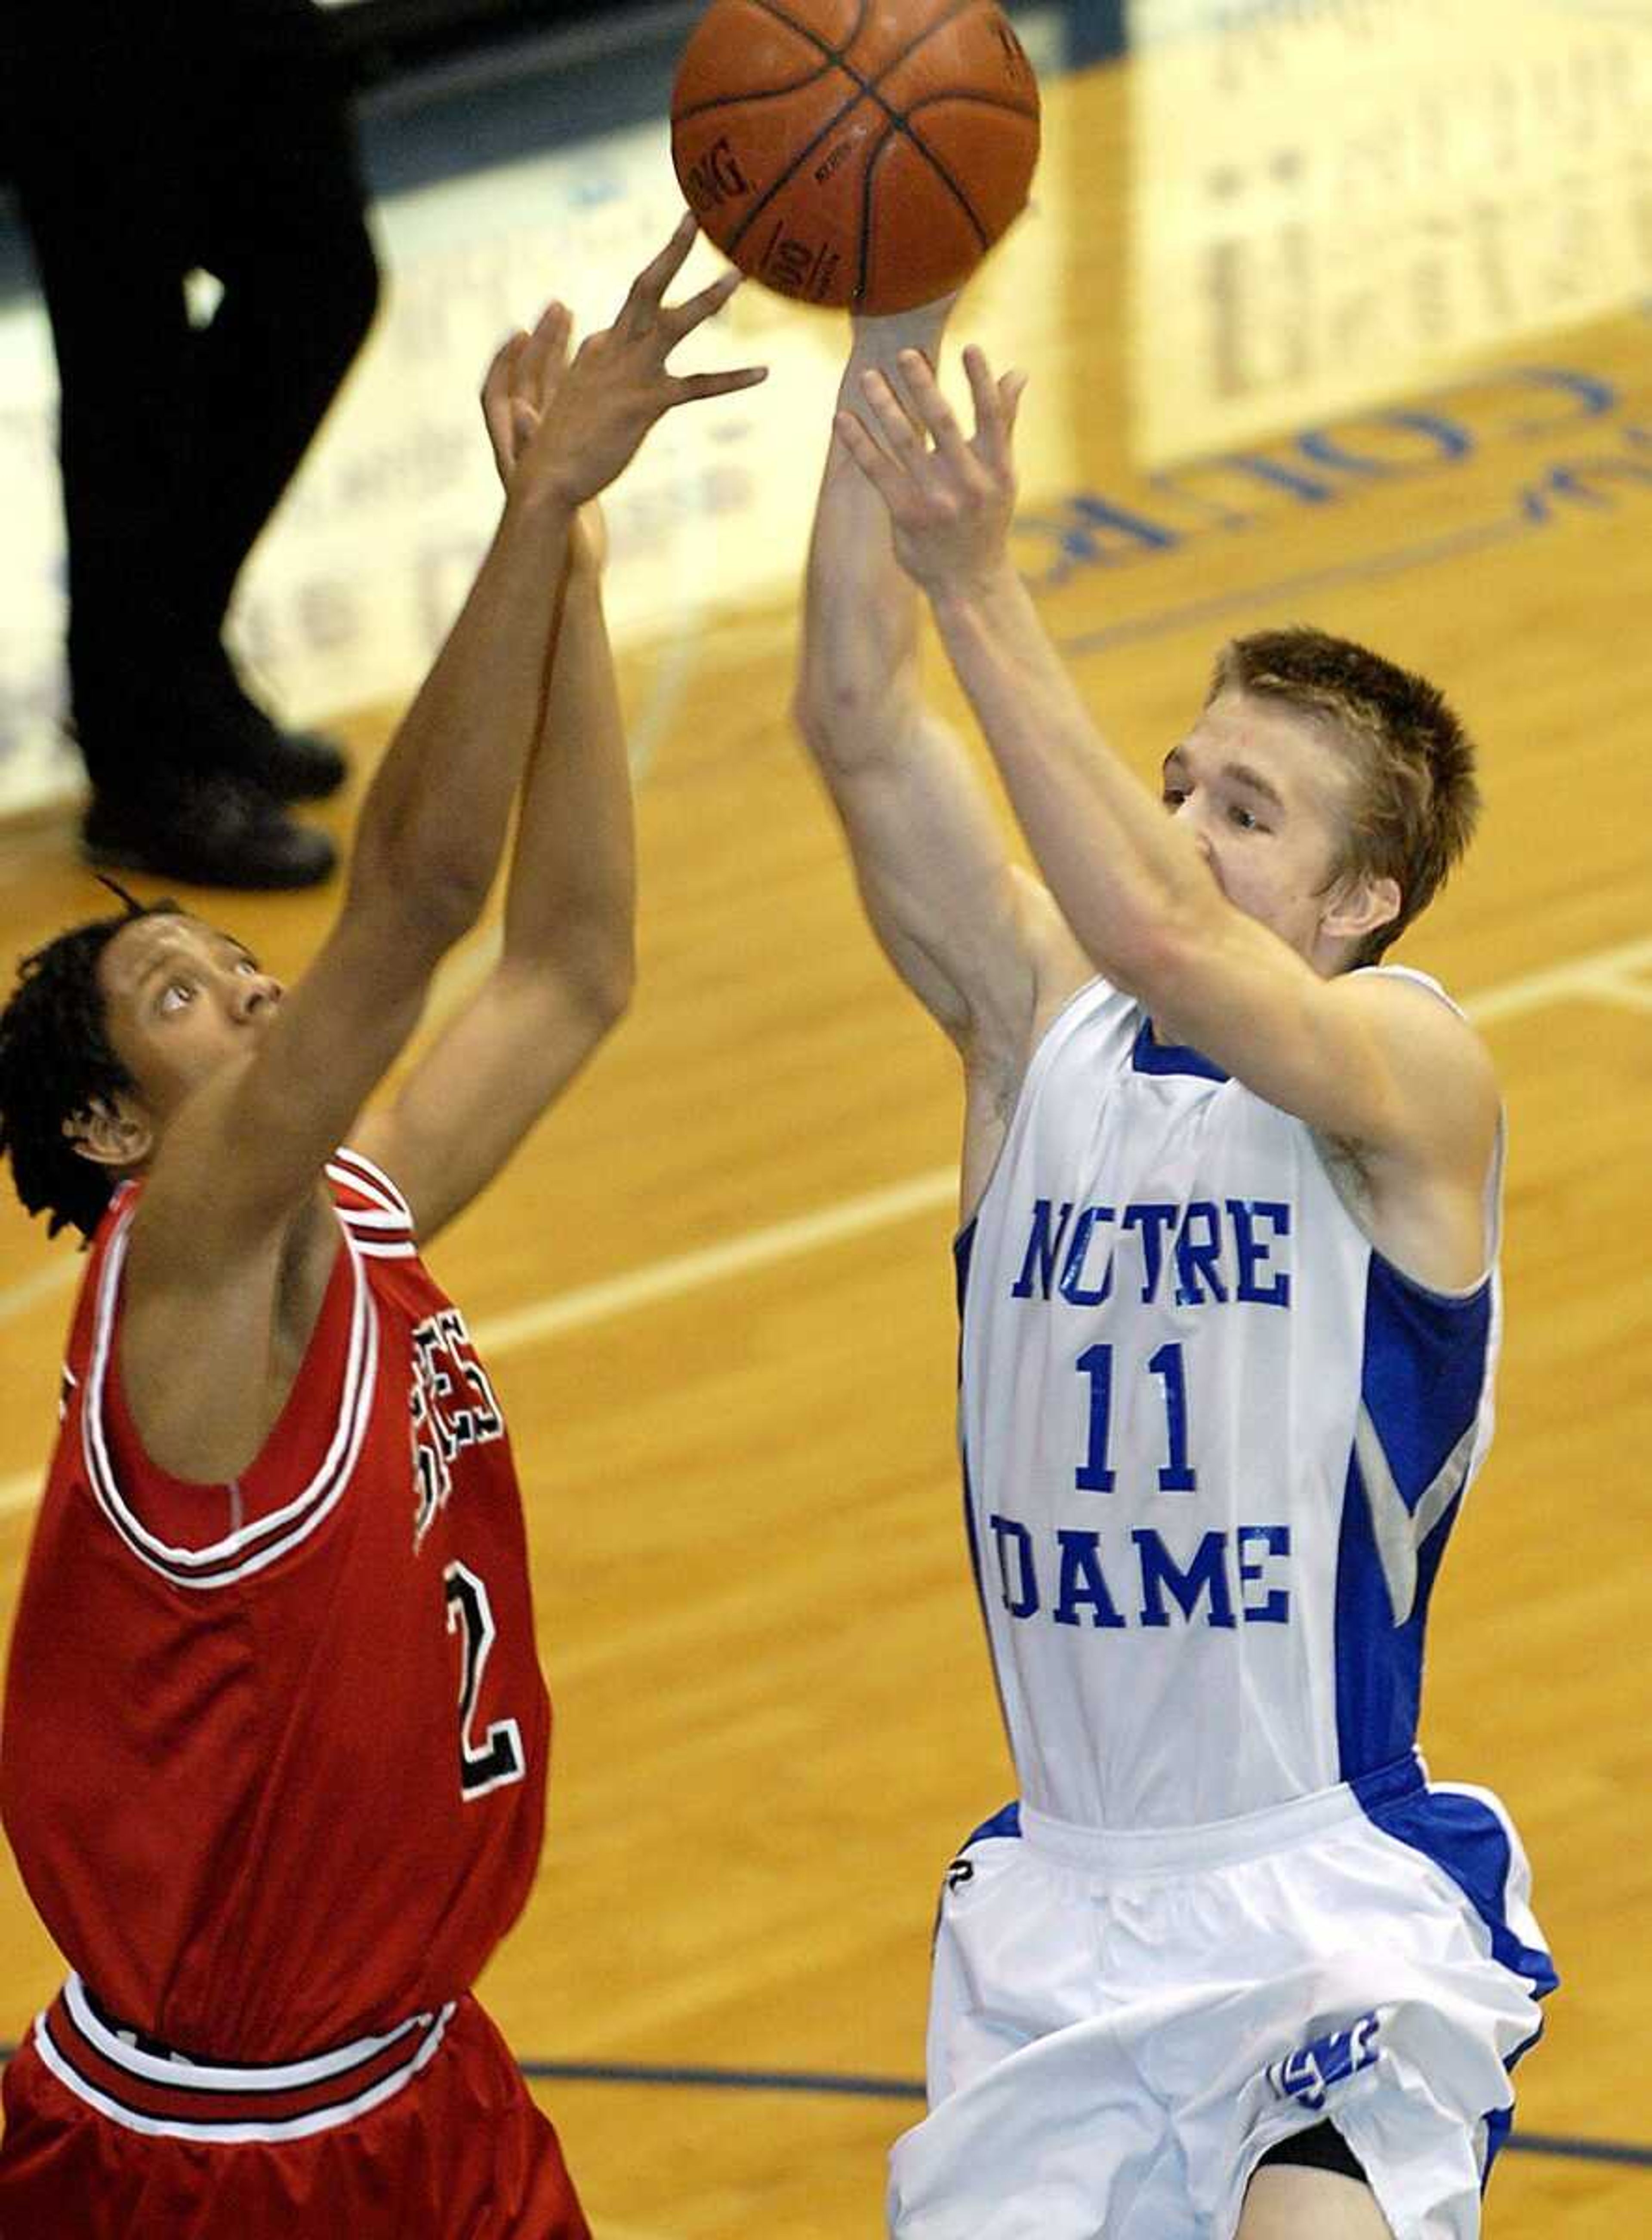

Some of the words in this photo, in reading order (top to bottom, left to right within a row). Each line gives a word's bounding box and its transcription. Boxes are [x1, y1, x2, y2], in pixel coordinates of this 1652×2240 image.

[1012, 1199, 1290, 1306] NOTRE
[1076, 1343, 1196, 1493] 11
[990, 1515, 1290, 1628] DAME
[444, 1559, 525, 1802] 2
